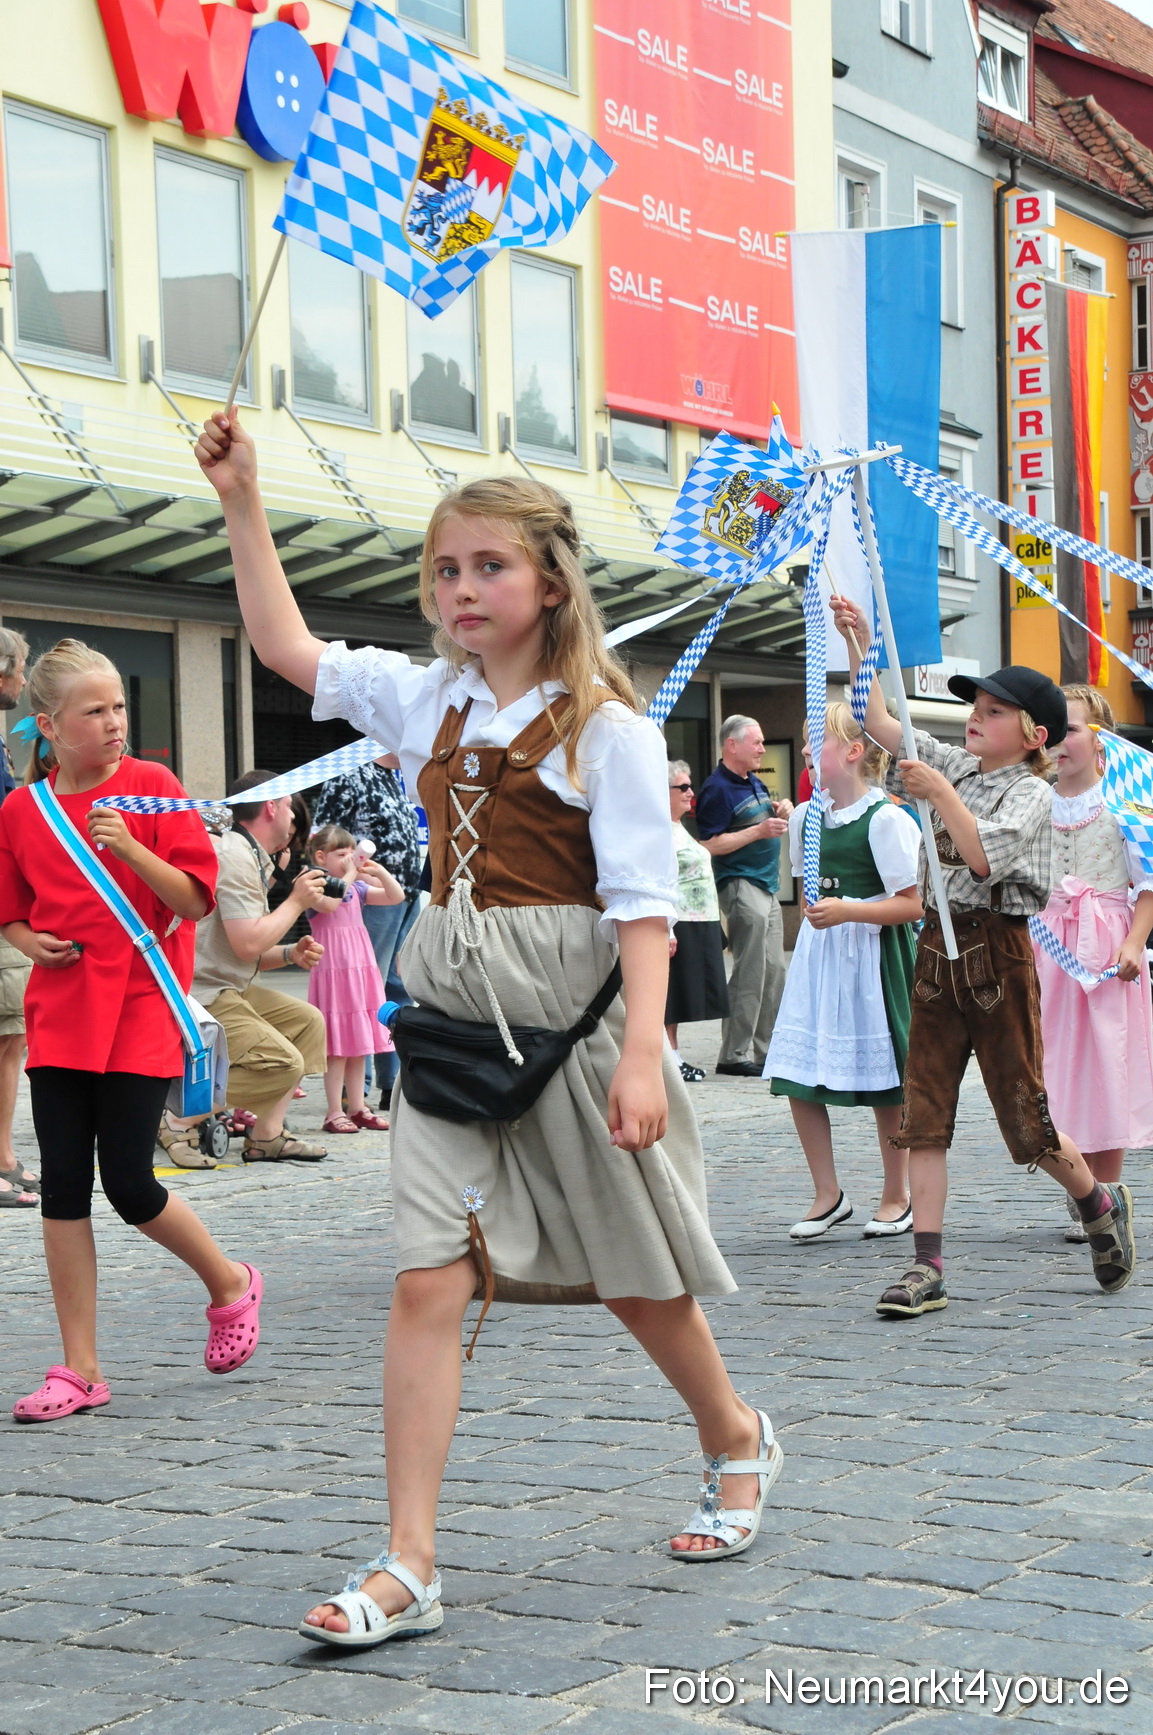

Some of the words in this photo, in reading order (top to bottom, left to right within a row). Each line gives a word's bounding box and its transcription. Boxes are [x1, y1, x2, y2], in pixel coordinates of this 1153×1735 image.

[97, 0, 338, 163] WÖ
[637, 28, 689, 73] SALE
[734, 68, 784, 109] SALE
[604, 98, 659, 142] SALE
[702, 137, 755, 176] SALE
[642, 194, 692, 234] SALE
[738, 226, 788, 263] SALE
[609, 266, 663, 304] SALE
[707, 295, 759, 331] SALE
[680, 373, 733, 405] WÖHRL
[1015, 197, 1044, 518] BÄCKEREI
